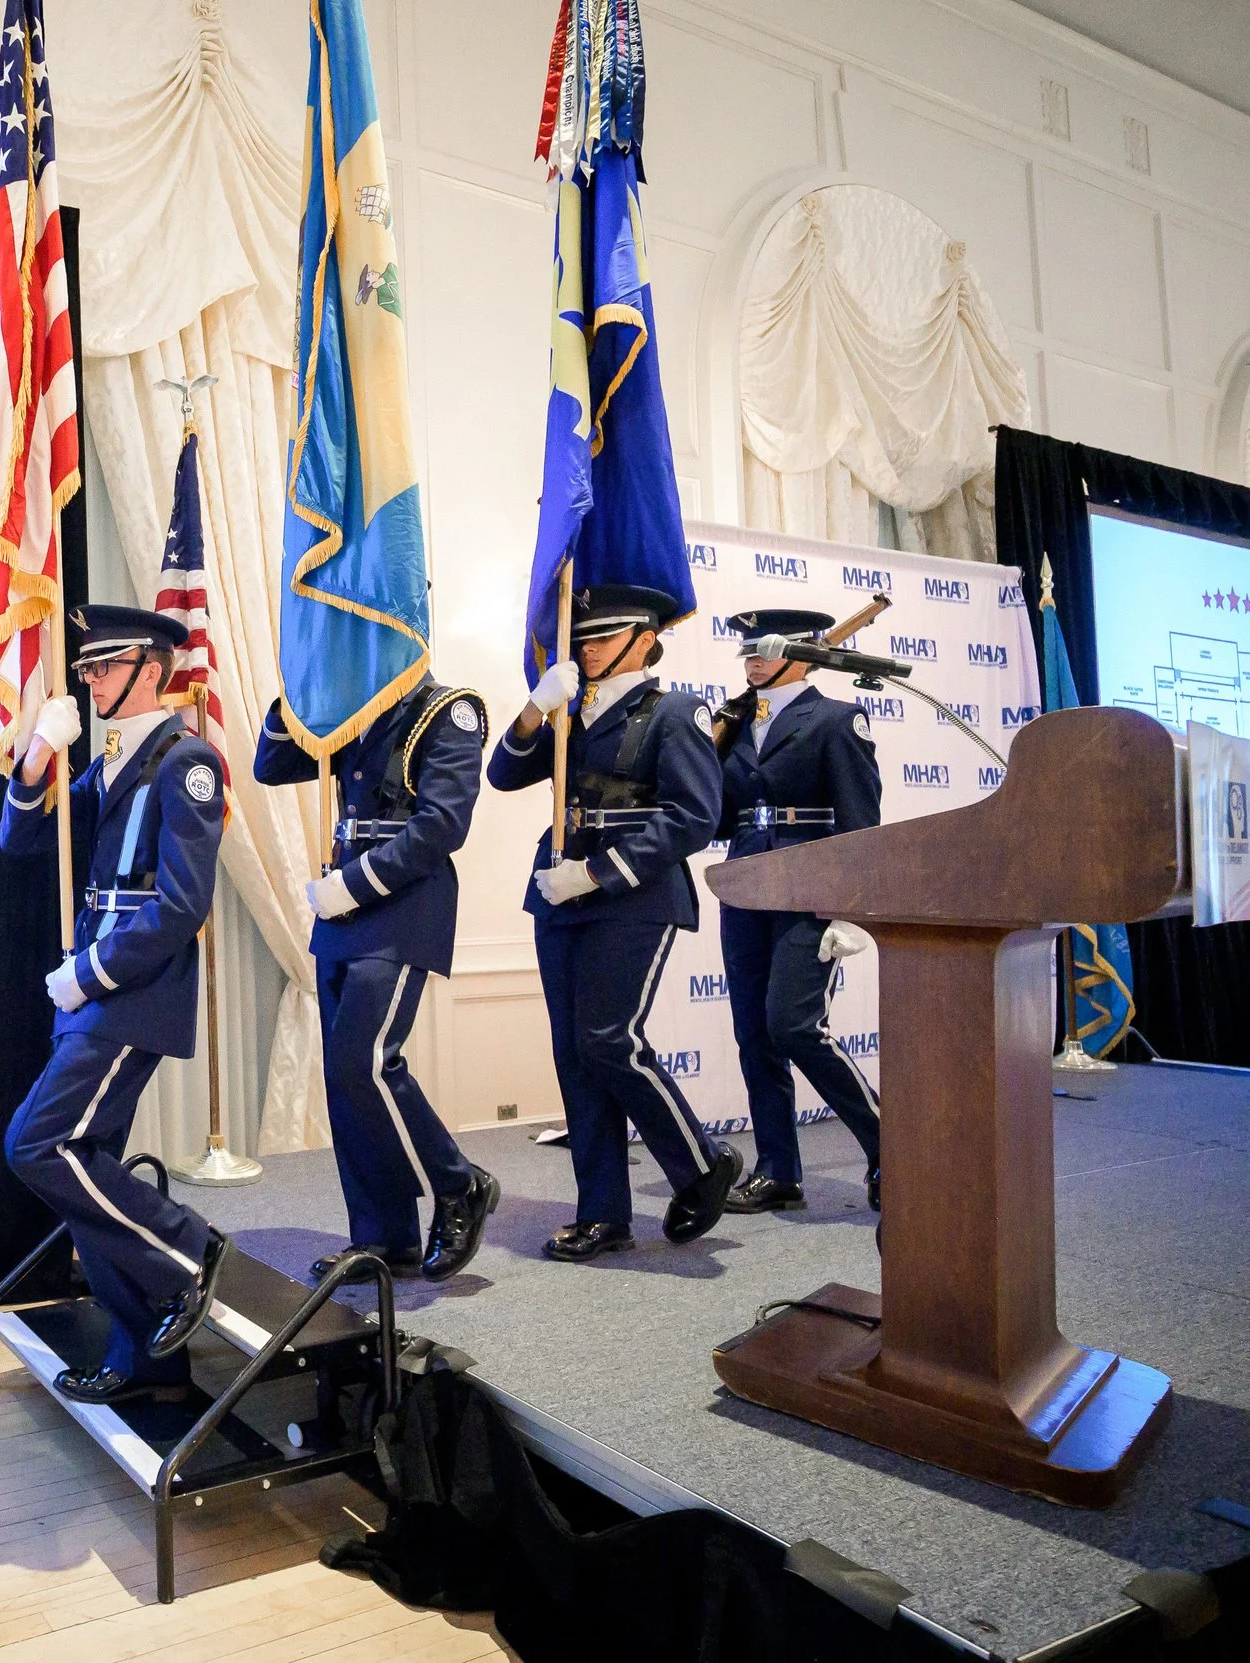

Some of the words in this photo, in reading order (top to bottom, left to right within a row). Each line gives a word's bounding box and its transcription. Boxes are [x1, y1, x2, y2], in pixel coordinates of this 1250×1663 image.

[563, 74, 574, 127] Champions
[755, 553, 799, 578] MHA
[843, 566, 884, 589] MHA
[924, 578, 964, 599] MHA
[891, 636, 930, 656] MHA
[904, 764, 940, 783] MHA
[979, 768, 1003, 785] MH
[192, 782, 210, 794] ROTC
[840, 1032, 878, 1054] MHA
[658, 1052, 688, 1074] HA
